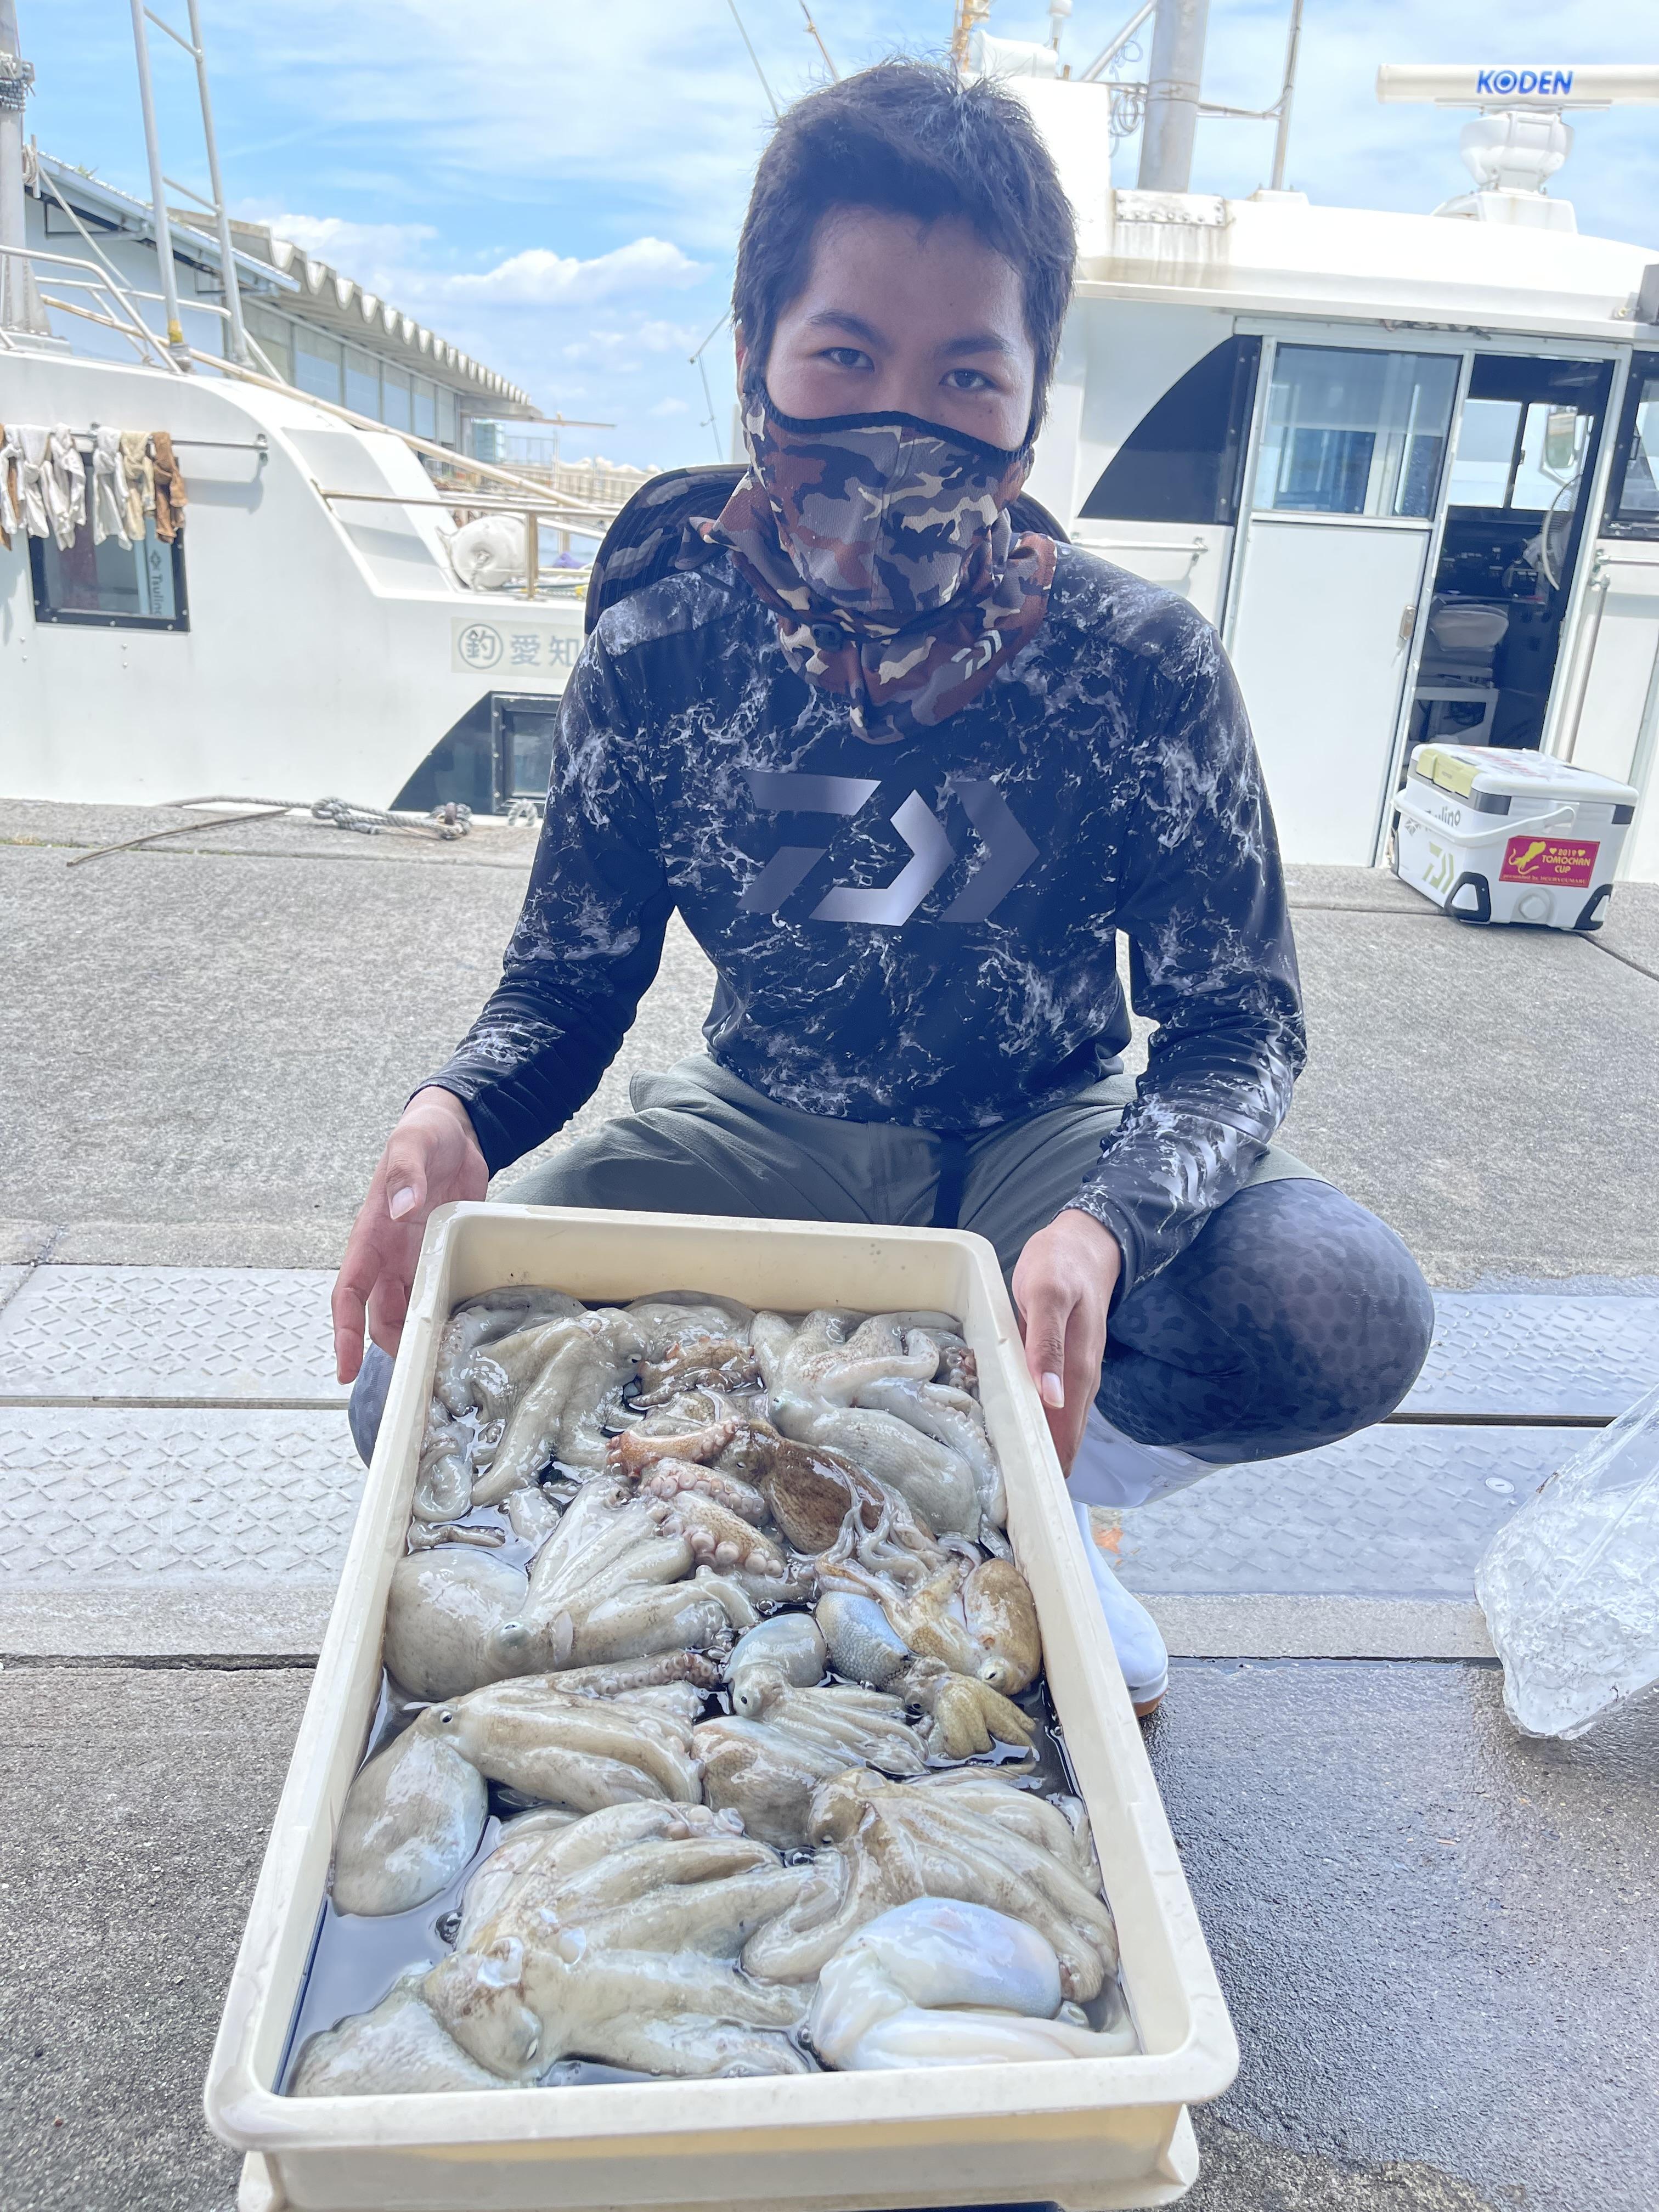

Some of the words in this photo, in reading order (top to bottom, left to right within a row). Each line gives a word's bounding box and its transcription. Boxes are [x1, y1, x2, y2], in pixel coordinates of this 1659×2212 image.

[1476, 70, 1573, 94] KODEN
[1542, 855, 1590, 866] TOMOCHAN
[1555, 865, 1571, 873] CUP
